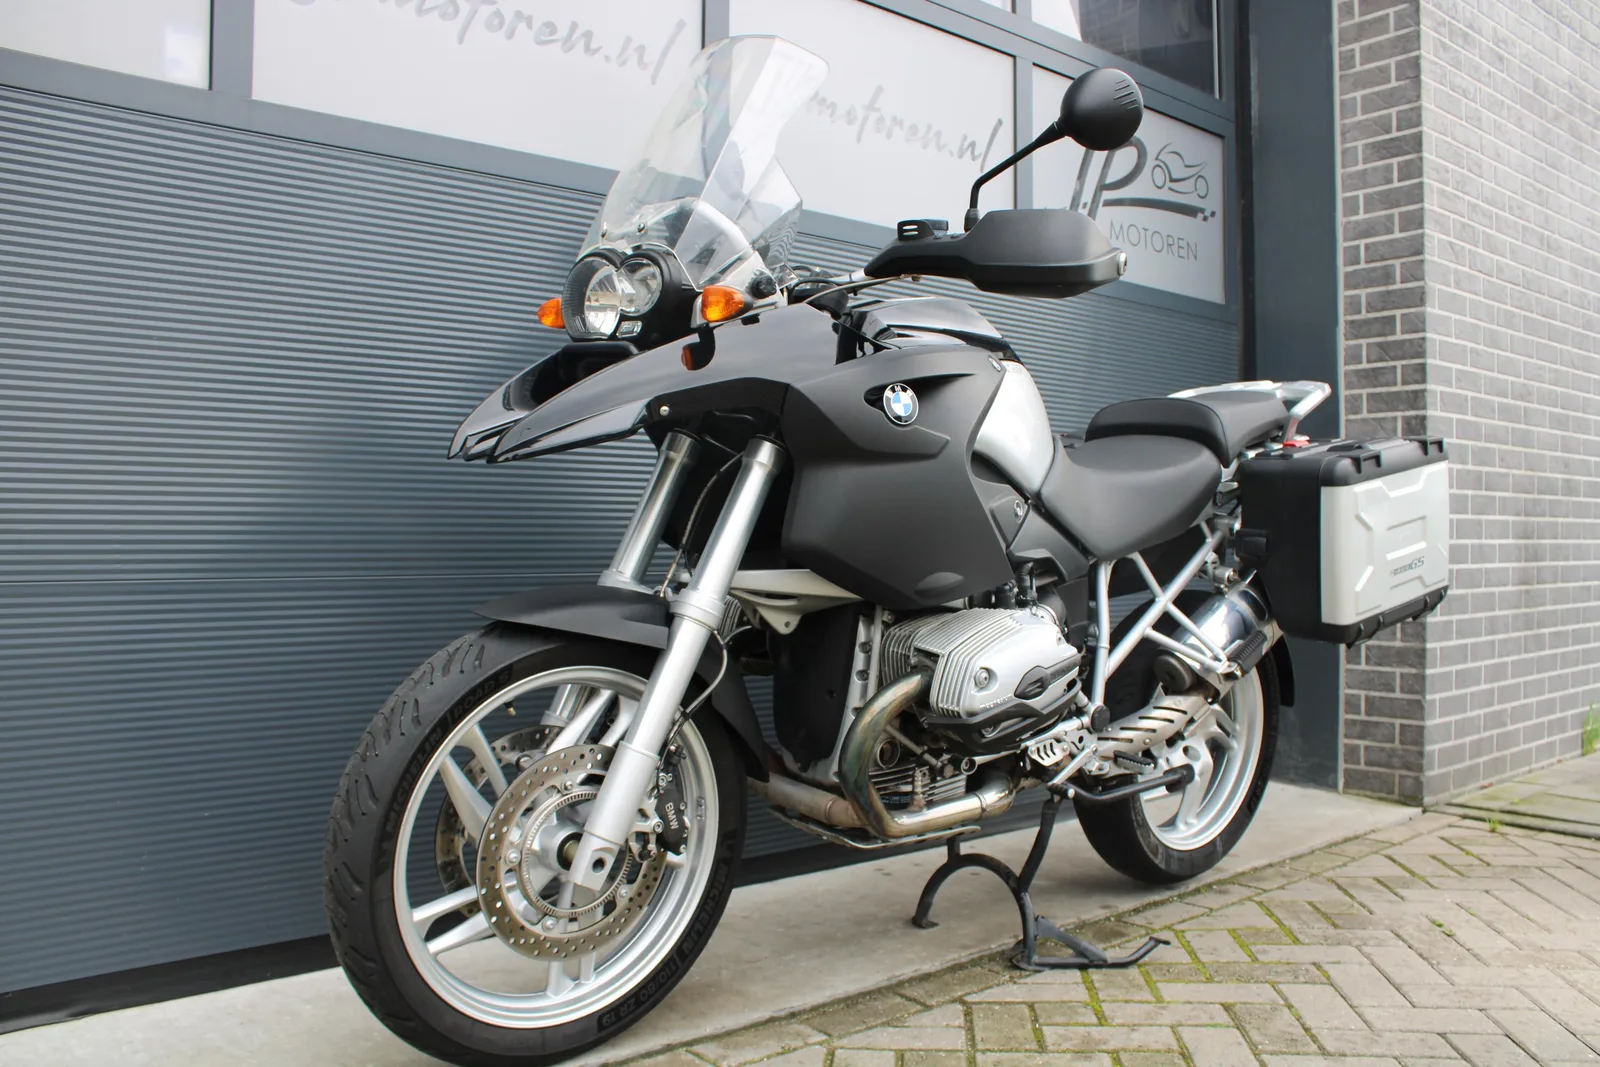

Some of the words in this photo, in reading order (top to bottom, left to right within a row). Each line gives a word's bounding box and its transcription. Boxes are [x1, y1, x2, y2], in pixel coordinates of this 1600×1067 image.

[1109, 219, 1198, 262] MOTOREN
[454, 681, 495, 721] ROAD
[665, 802, 680, 830] BMW
[683, 864, 729, 955] MICHELIN
